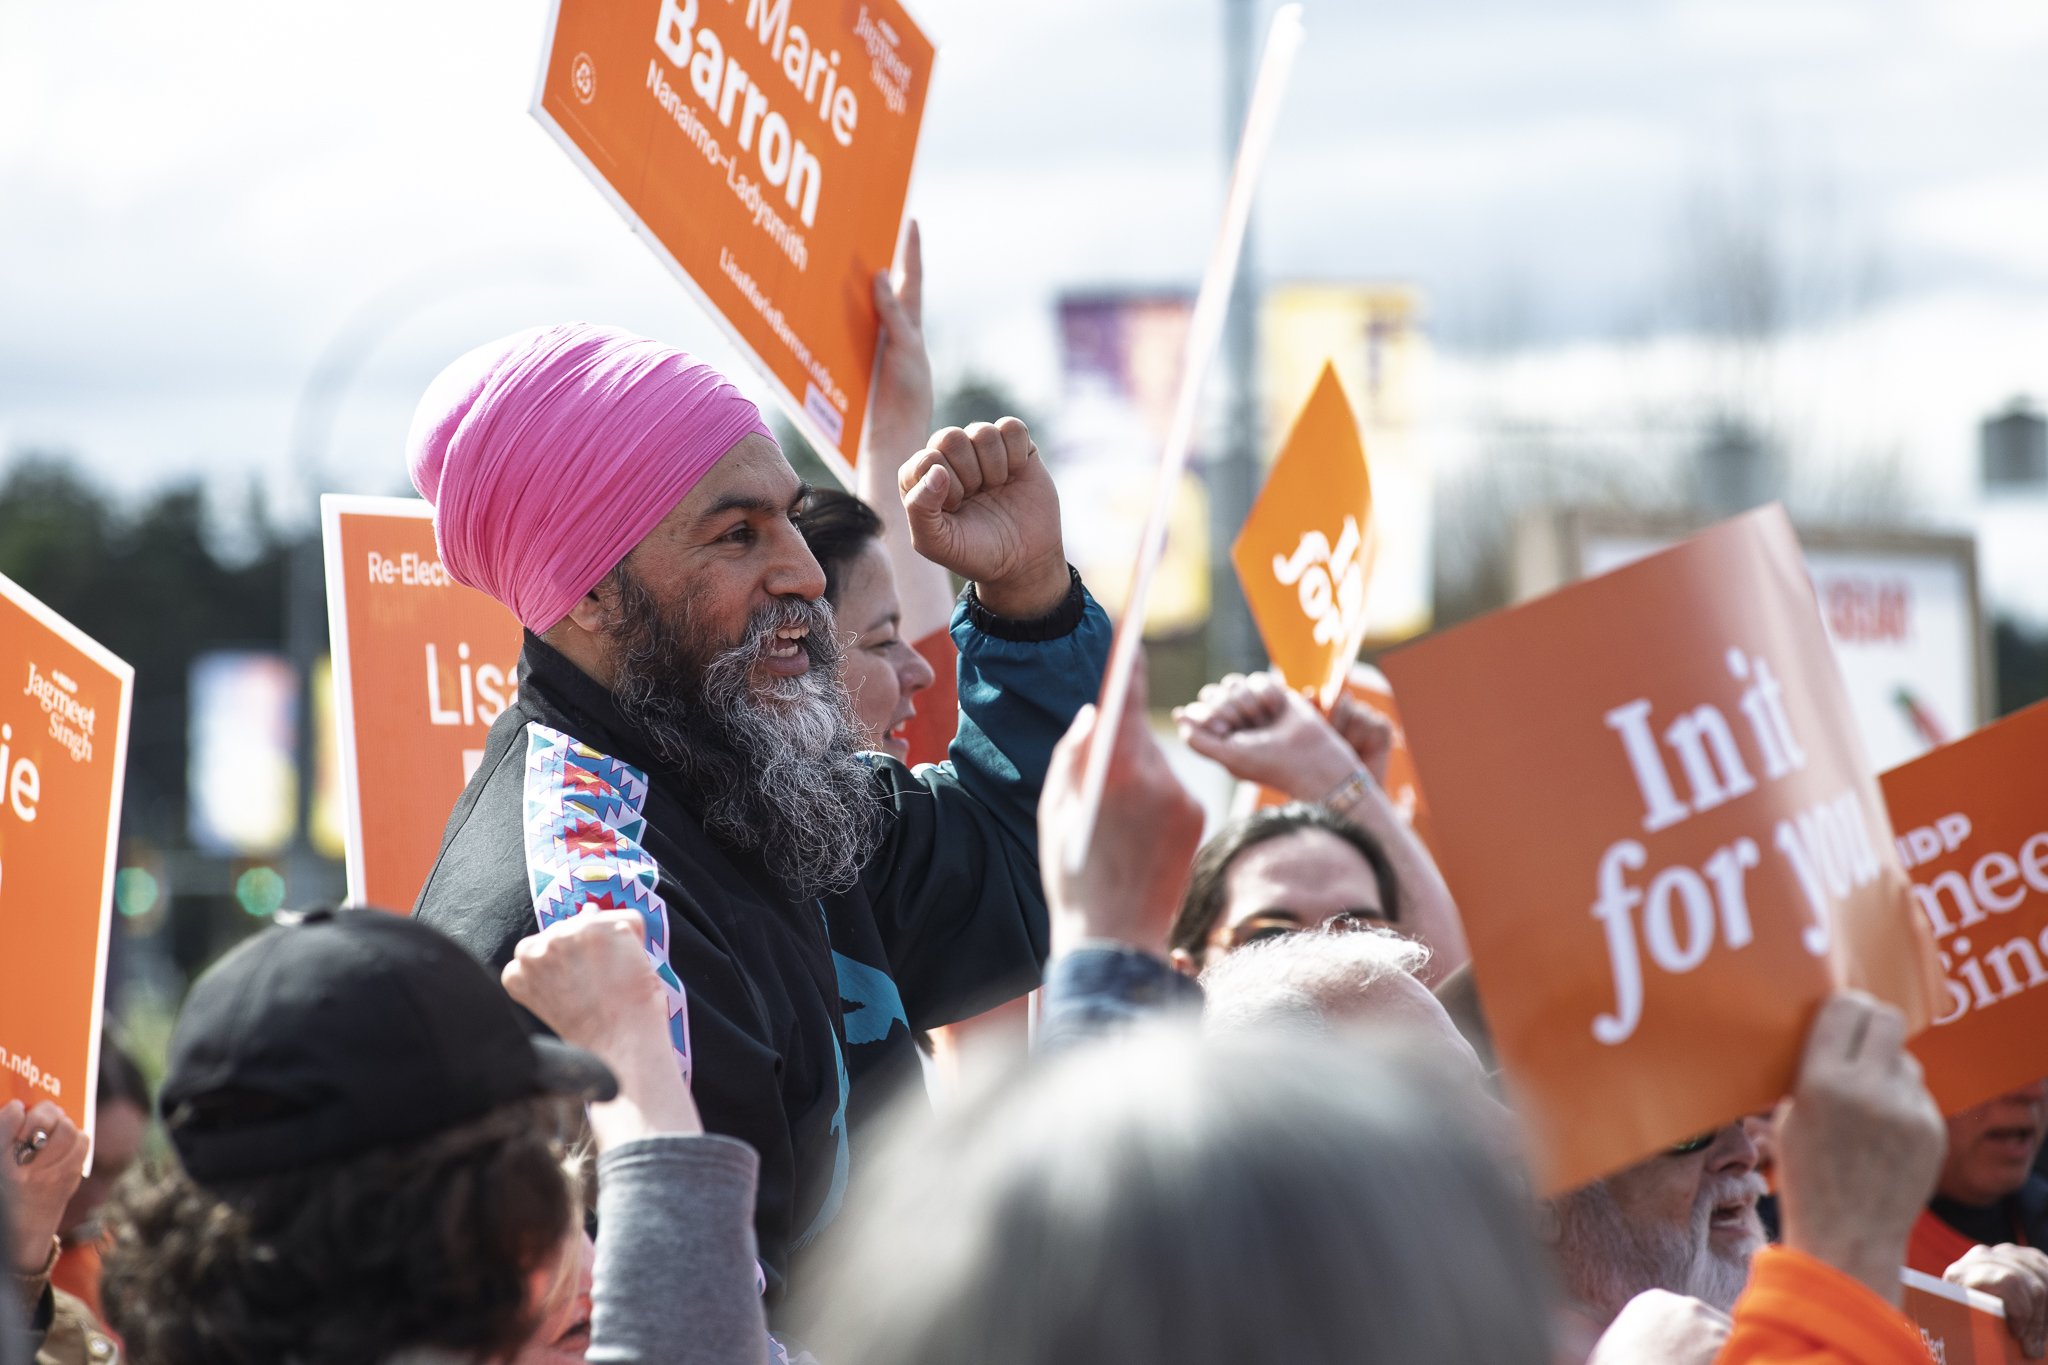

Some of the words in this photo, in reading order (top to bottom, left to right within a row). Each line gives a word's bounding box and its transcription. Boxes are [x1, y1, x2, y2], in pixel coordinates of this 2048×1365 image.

[654, 0, 822, 229] Barron
[746, 0, 858, 146] Marie
[23, 661, 96, 736] Jagmeet
[48, 711, 93, 763] Singh
[425, 642, 518, 727] Lis
[1603, 696, 1756, 833] In
[1724, 645, 1806, 780] it
[1590, 838, 1760, 1045] for
[1774, 787, 1882, 957] you
[1931, 925, 2048, 1026] Sin
